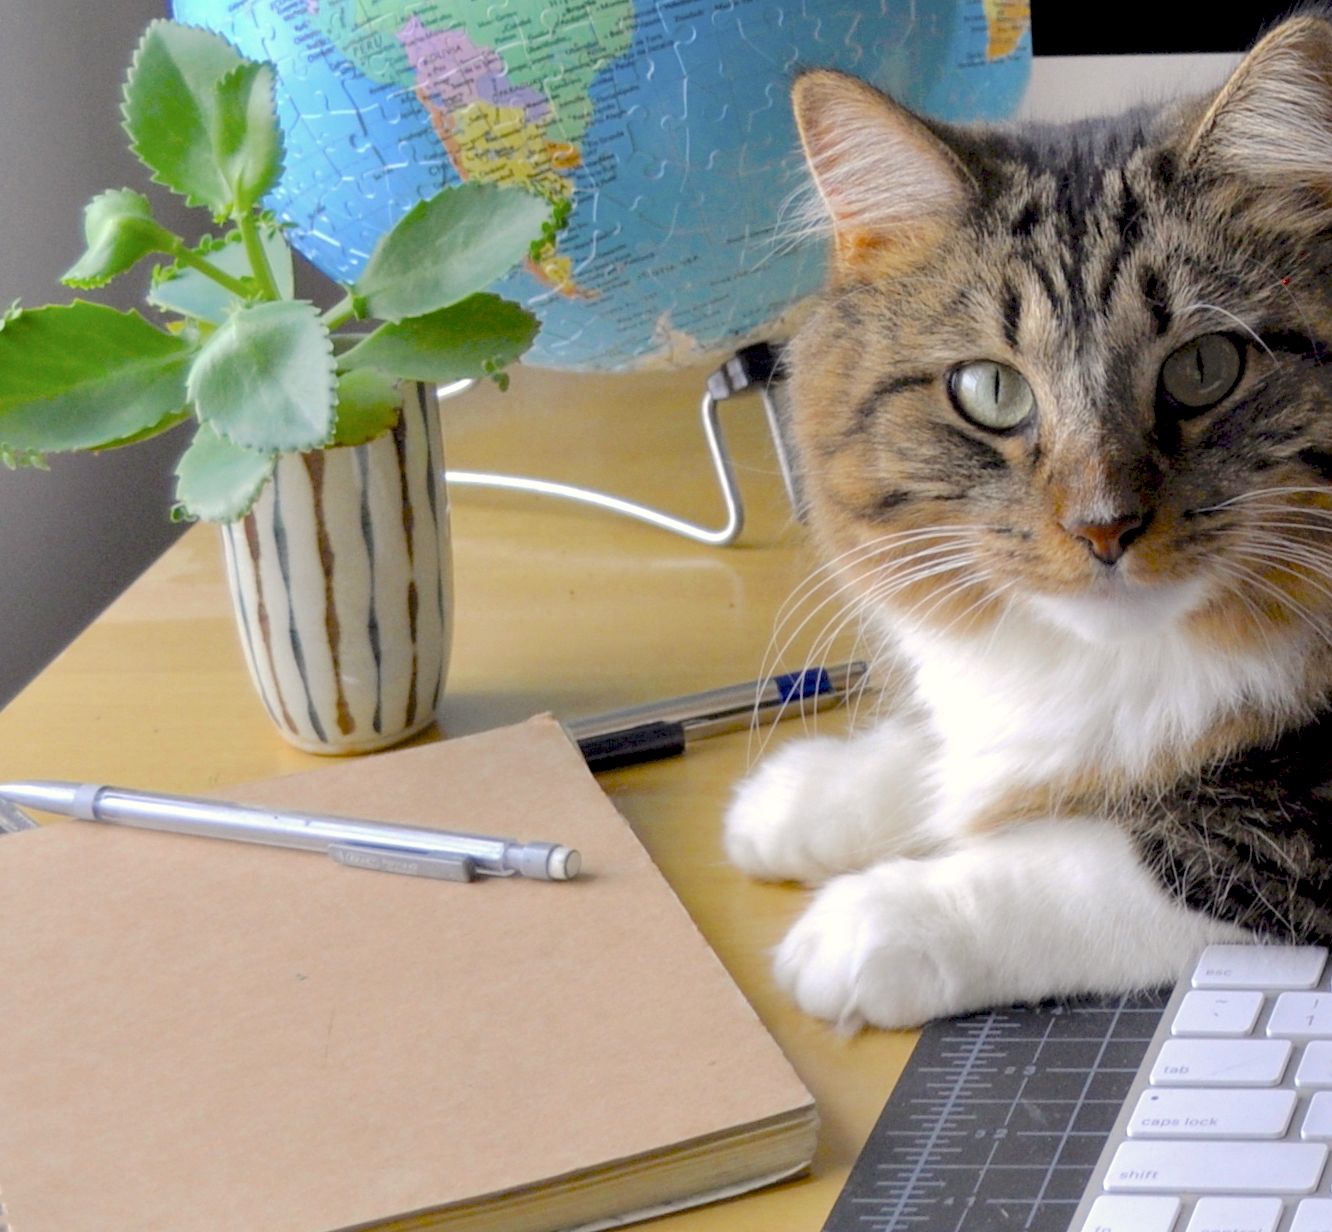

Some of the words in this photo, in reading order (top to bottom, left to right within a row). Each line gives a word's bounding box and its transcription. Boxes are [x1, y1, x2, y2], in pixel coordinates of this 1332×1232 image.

[352, 36, 383, 58] PERU
[1307, 1014, 1315, 1027] 1
[1163, 1065, 1190, 1075] tab
[1141, 1118, 1181, 1128] caps
[1184, 1117, 1218, 1127] lock
[1119, 1170, 1159, 1180] shift
